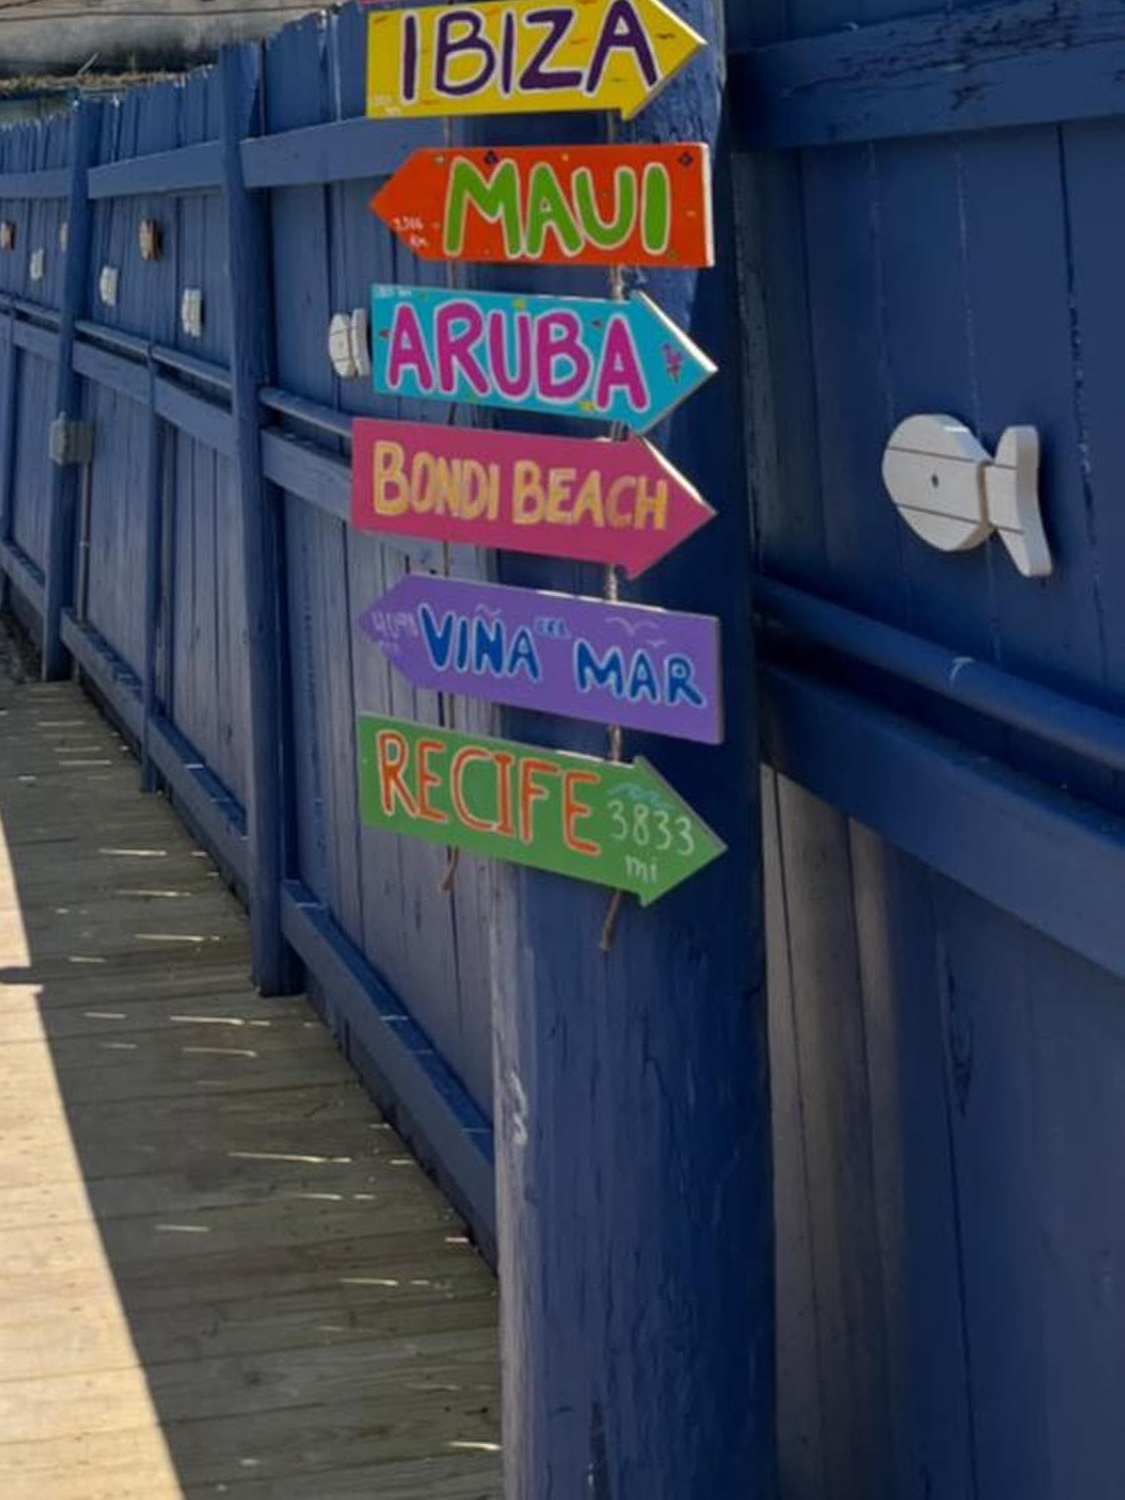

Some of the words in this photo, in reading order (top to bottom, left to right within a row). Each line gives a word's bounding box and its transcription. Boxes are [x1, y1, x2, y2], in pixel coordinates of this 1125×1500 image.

[443, 156, 671, 259] MAUI
[386, 298, 651, 412] ARUBA
[374, 440, 501, 521] BONDI
[511, 459, 669, 532] BEACH
[417, 603, 542, 683] VIÑA
[575, 637, 709, 710] MAR
[377, 729, 603, 857] RECIFE
[607, 800, 696, 857] 3833
[624, 853, 659, 884] mi
